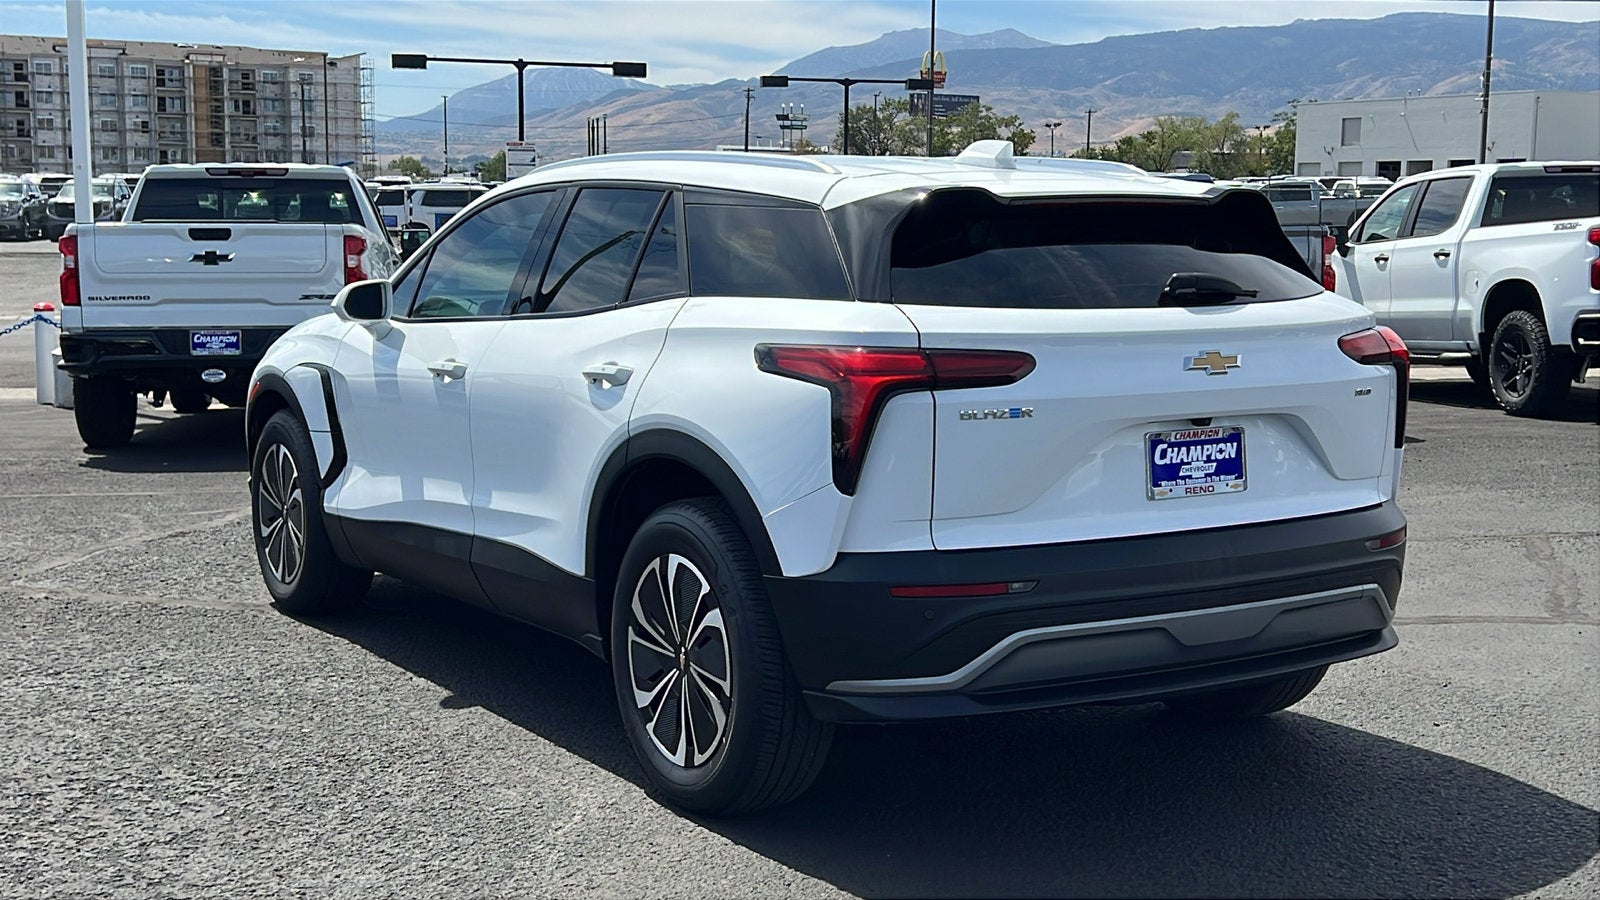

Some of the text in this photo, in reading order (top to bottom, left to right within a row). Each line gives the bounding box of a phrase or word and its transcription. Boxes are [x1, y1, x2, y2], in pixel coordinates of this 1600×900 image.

[193, 334, 238, 343] CHAMPION
[959, 407, 1034, 421] BLAZER
[1174, 429, 1220, 440] CHAMPION
[1154, 442, 1238, 465] CHAMPION
[1181, 464, 1215, 473] CHEVROLET
[1185, 485, 1215, 495] RENO
